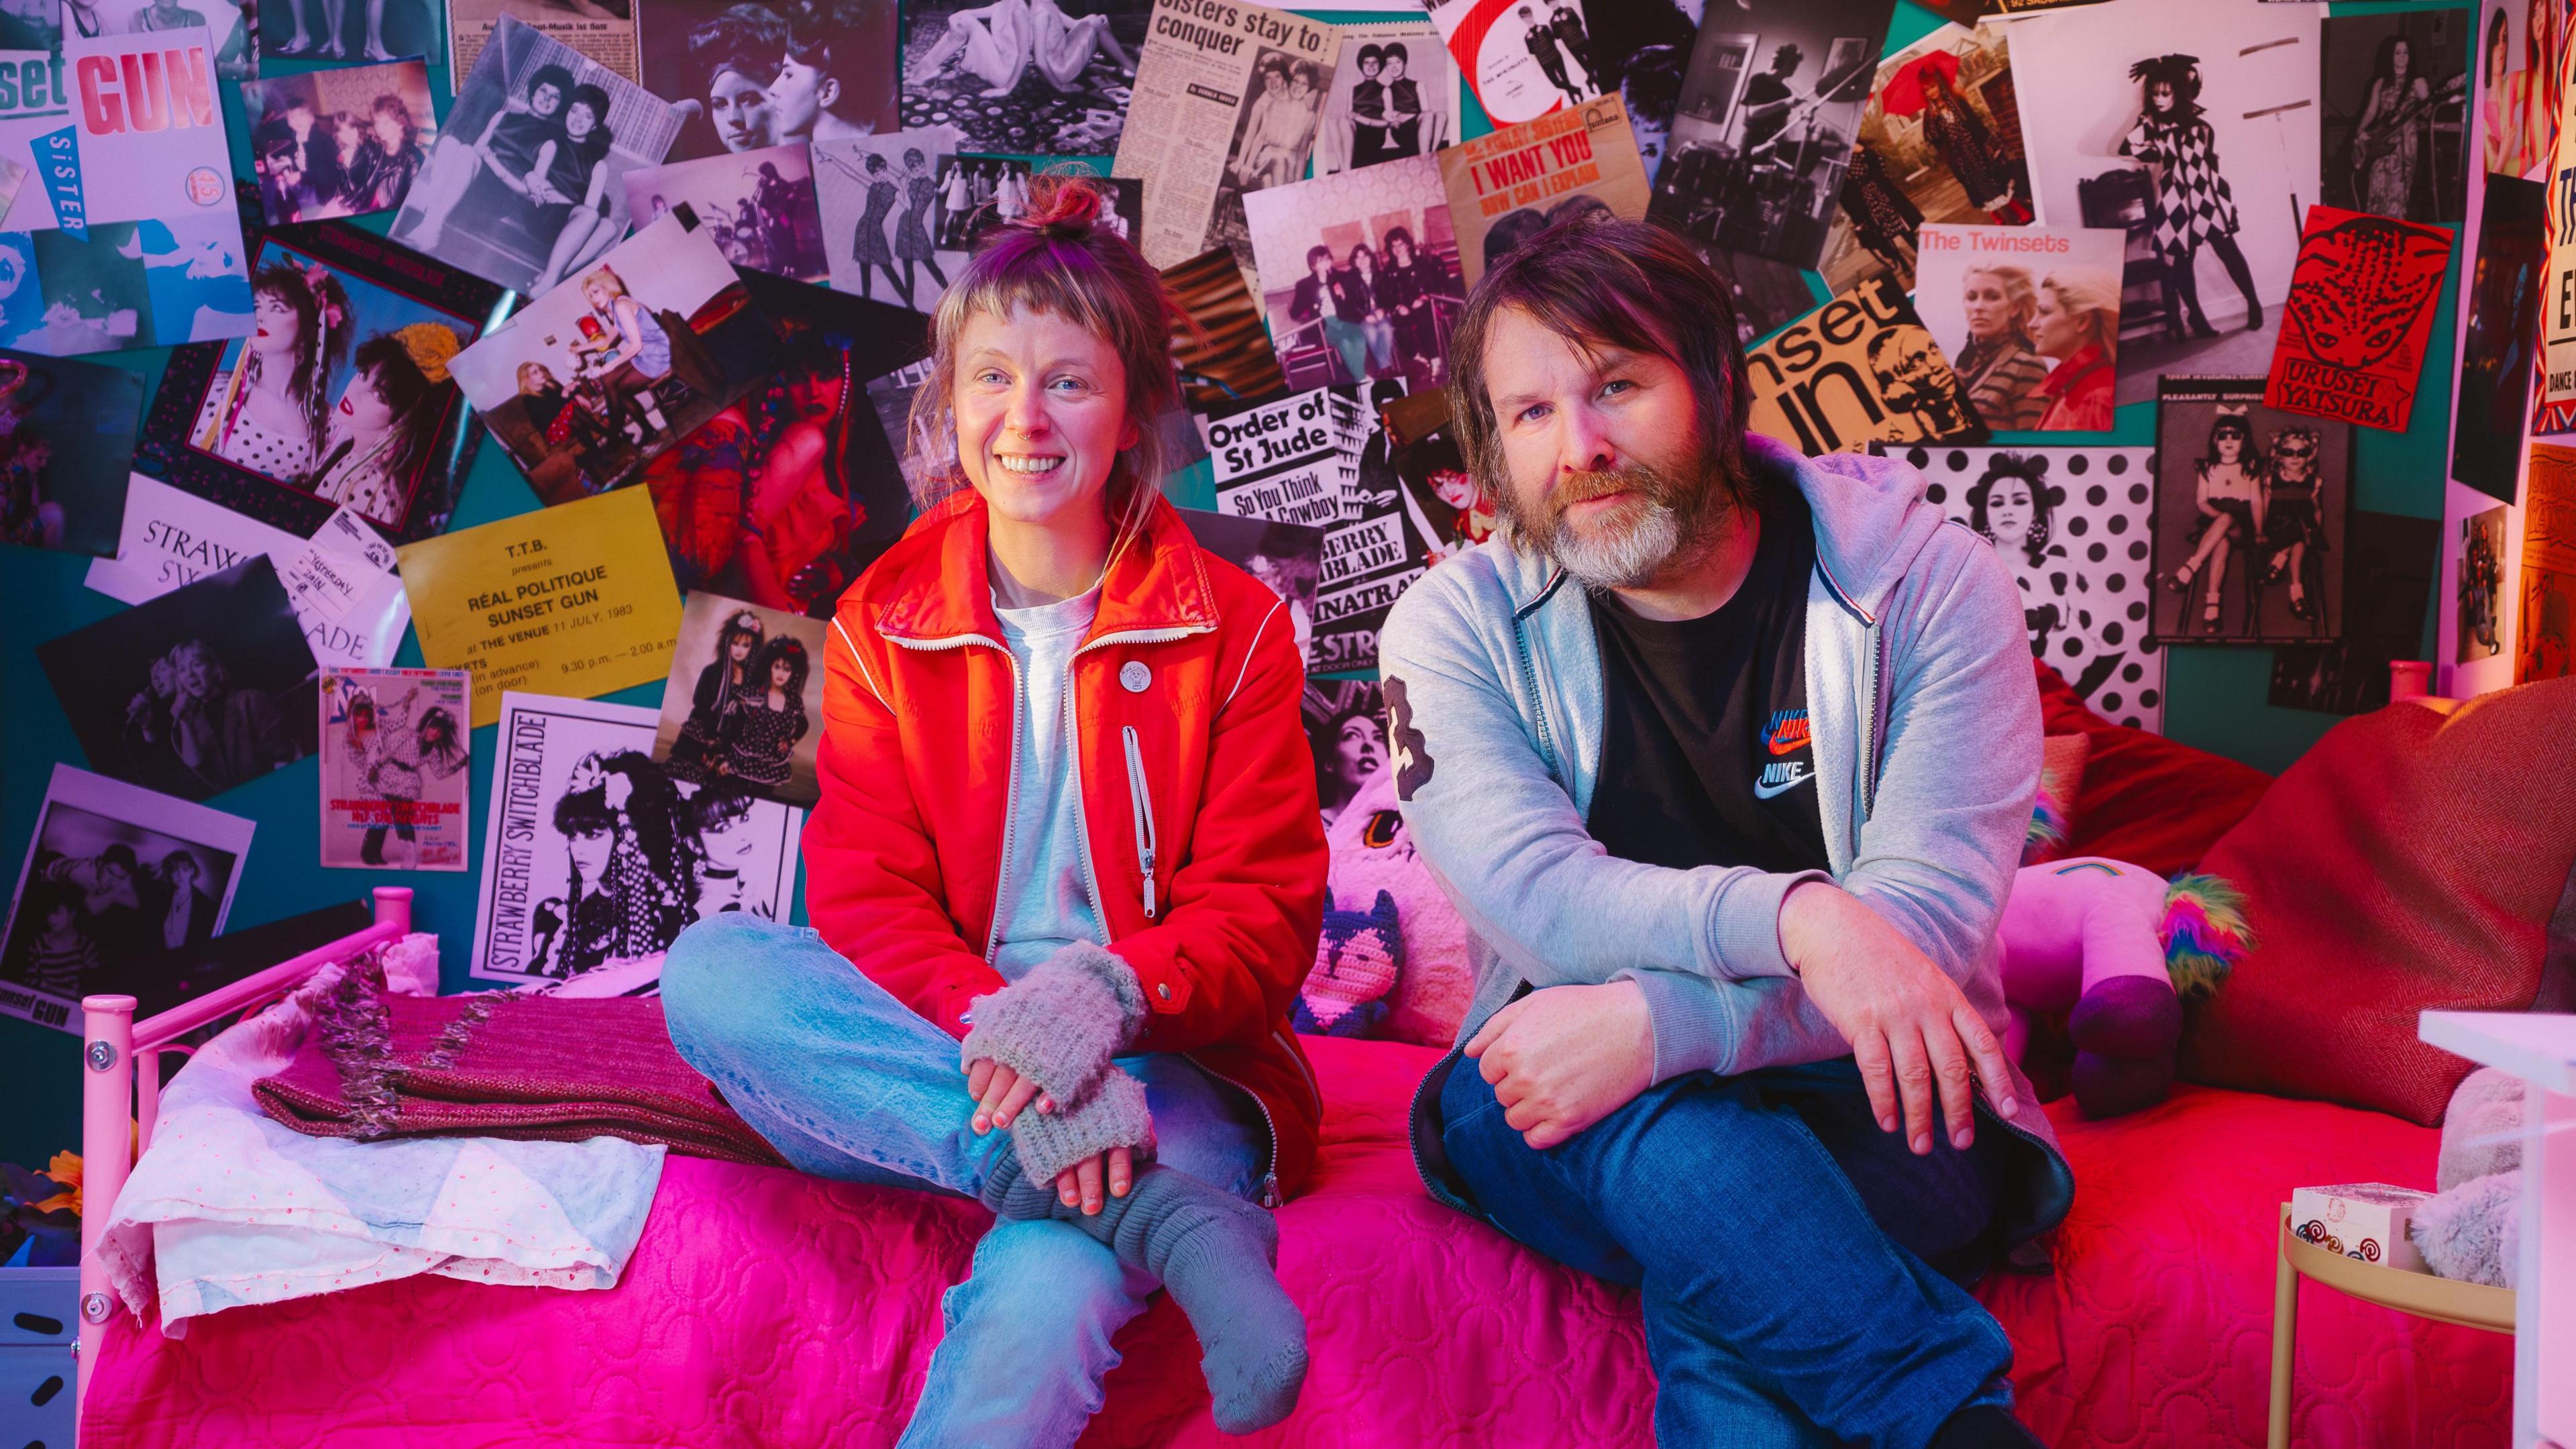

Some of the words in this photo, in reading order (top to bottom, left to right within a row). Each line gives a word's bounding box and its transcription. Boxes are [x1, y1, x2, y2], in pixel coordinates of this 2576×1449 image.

[1156, 15, 1244, 56] conquer
[1244, 12, 1293, 47] stay
[1298, 24, 1321, 52] to
[76, 47, 213, 136] GUN
[1470, 166, 1484, 197] I
[1485, 144, 1546, 191] WANT
[1548, 129, 1593, 168] YOU
[1921, 230, 1961, 251] The
[1968, 231, 2070, 254] Twinsets
[2161, 393, 2218, 401] PLEASANTLY
[2288, 361, 2378, 398] URUSEI
[2549, 370, 2572, 393] DANCE
[1208, 409, 1289, 449] Order
[1297, 391, 1326, 421] of
[2284, 382, 2391, 425] YATSURA
[1224, 446, 1254, 474] St
[1257, 426, 1328, 464] Jude
[1233, 494, 1256, 517] So
[1252, 487, 1282, 511] You
[1279, 471, 1323, 502] Think
[1277, 494, 1340, 525] Cowboy
[504, 539, 548, 558] T.T.B.
[511, 558, 553, 578] presents
[467, 590, 513, 612] RÉAL
[516, 565, 608, 600] POLITIQUE
[487, 598, 554, 629] SUNSET
[559, 588, 599, 610] GUN
[481, 639, 506, 652] THE
[508, 624, 551, 645] VENUE
[606, 603, 634, 619] 1983
[490, 659, 541, 680] advance)
[560, 659, 585, 674] 9.30
[629, 642, 653, 657] 2.00
[496, 675, 529, 692] door)
[505, 715, 547, 843] SWITCHBLADE
[1762, 761, 1804, 784] NIKE
[490, 843, 533, 968] STRAWBERRY
[32, 999, 70, 1029] GUN
